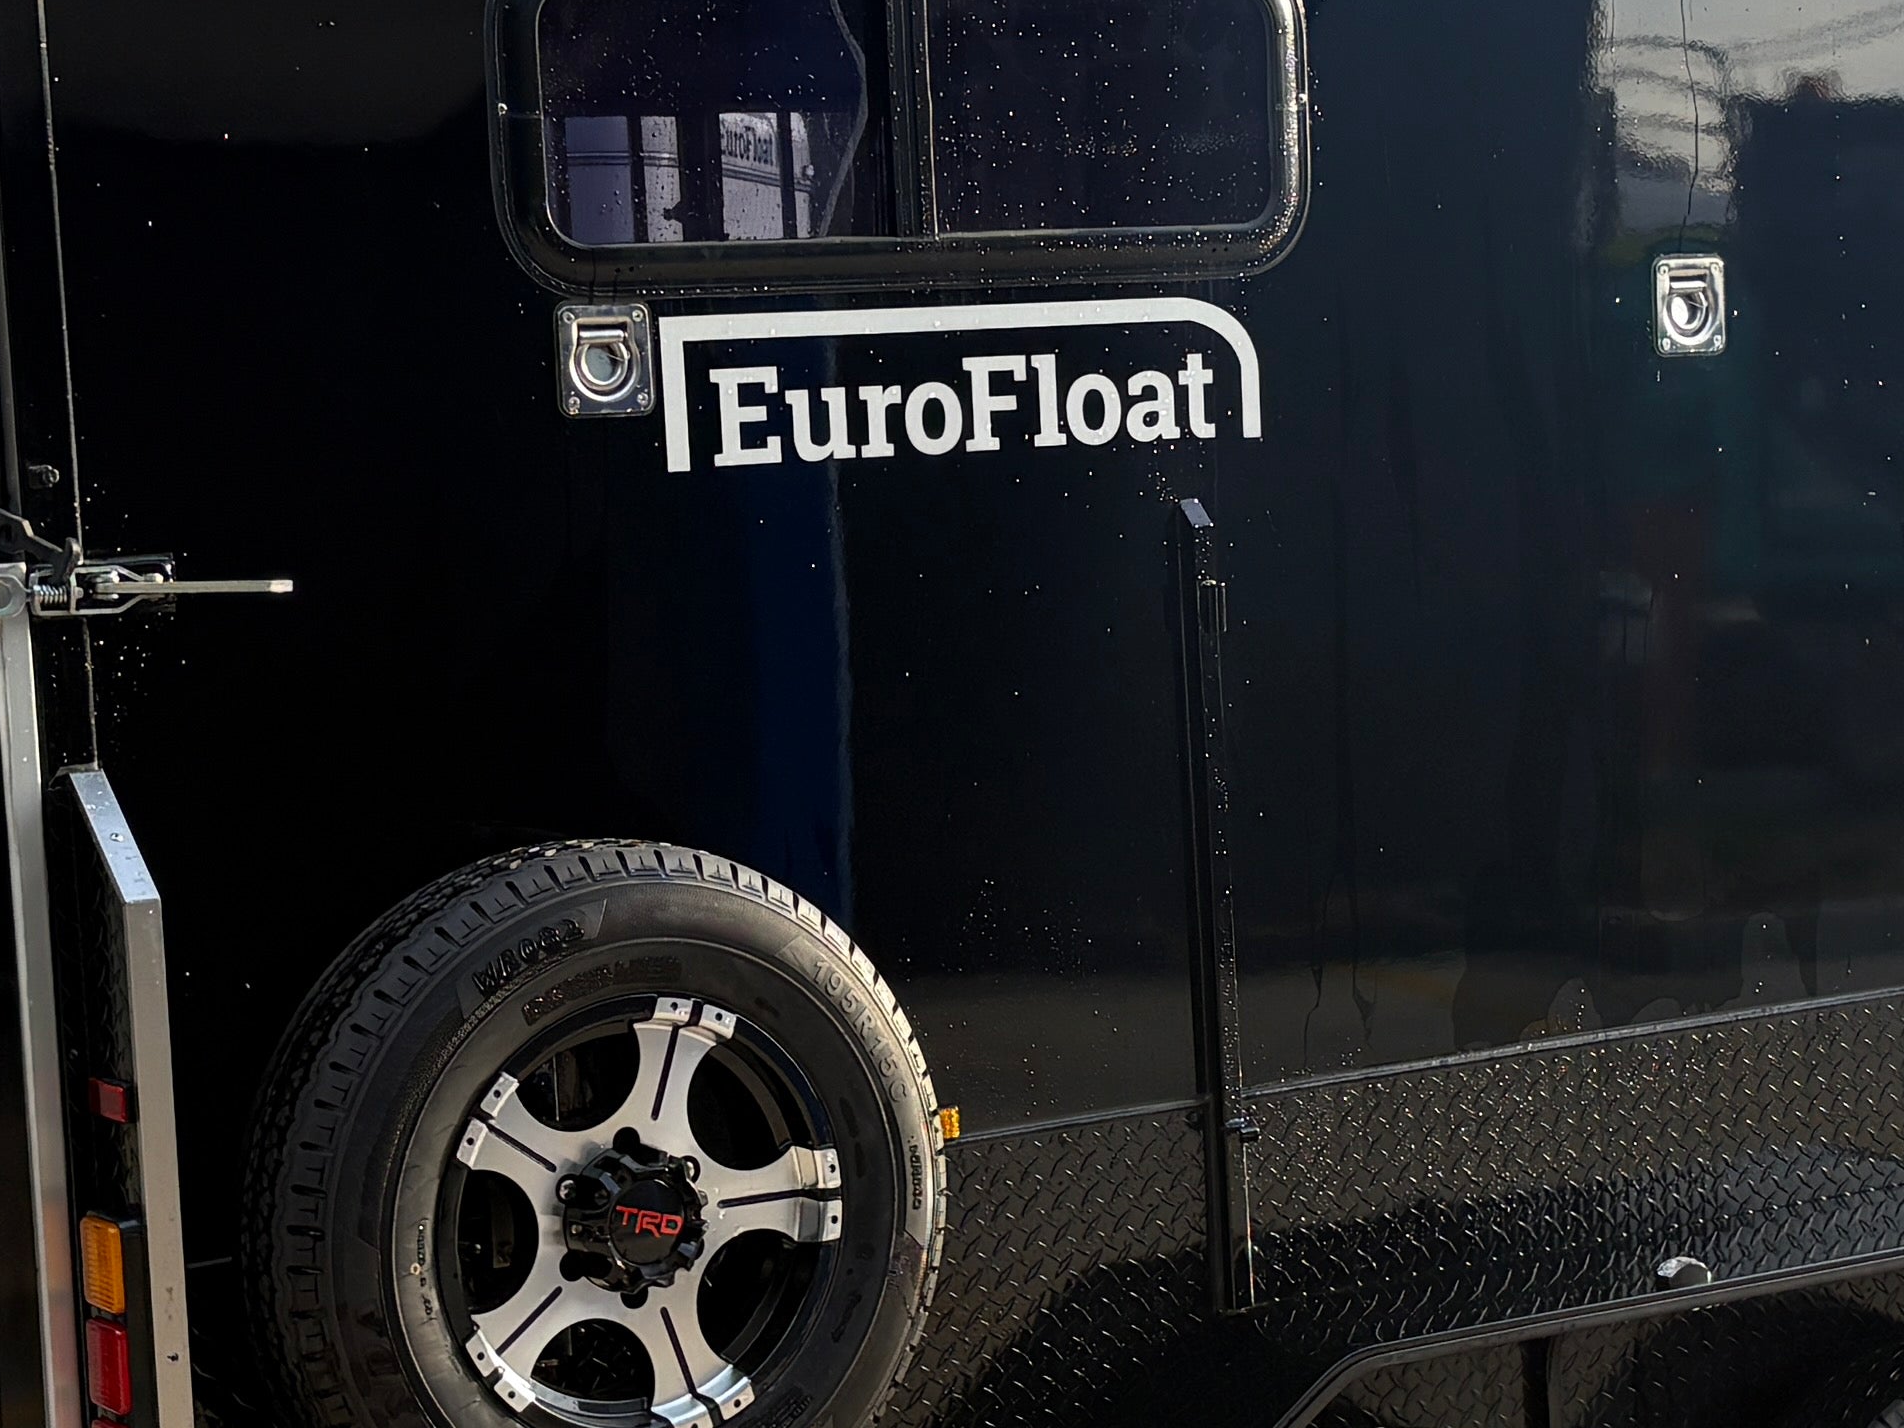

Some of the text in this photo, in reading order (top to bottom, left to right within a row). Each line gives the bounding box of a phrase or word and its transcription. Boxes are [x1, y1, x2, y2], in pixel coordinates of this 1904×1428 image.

[708, 351, 1218, 468] EuroFloat
[812, 957, 908, 1104] 195R15C
[616, 1204, 683, 1239] TRD
